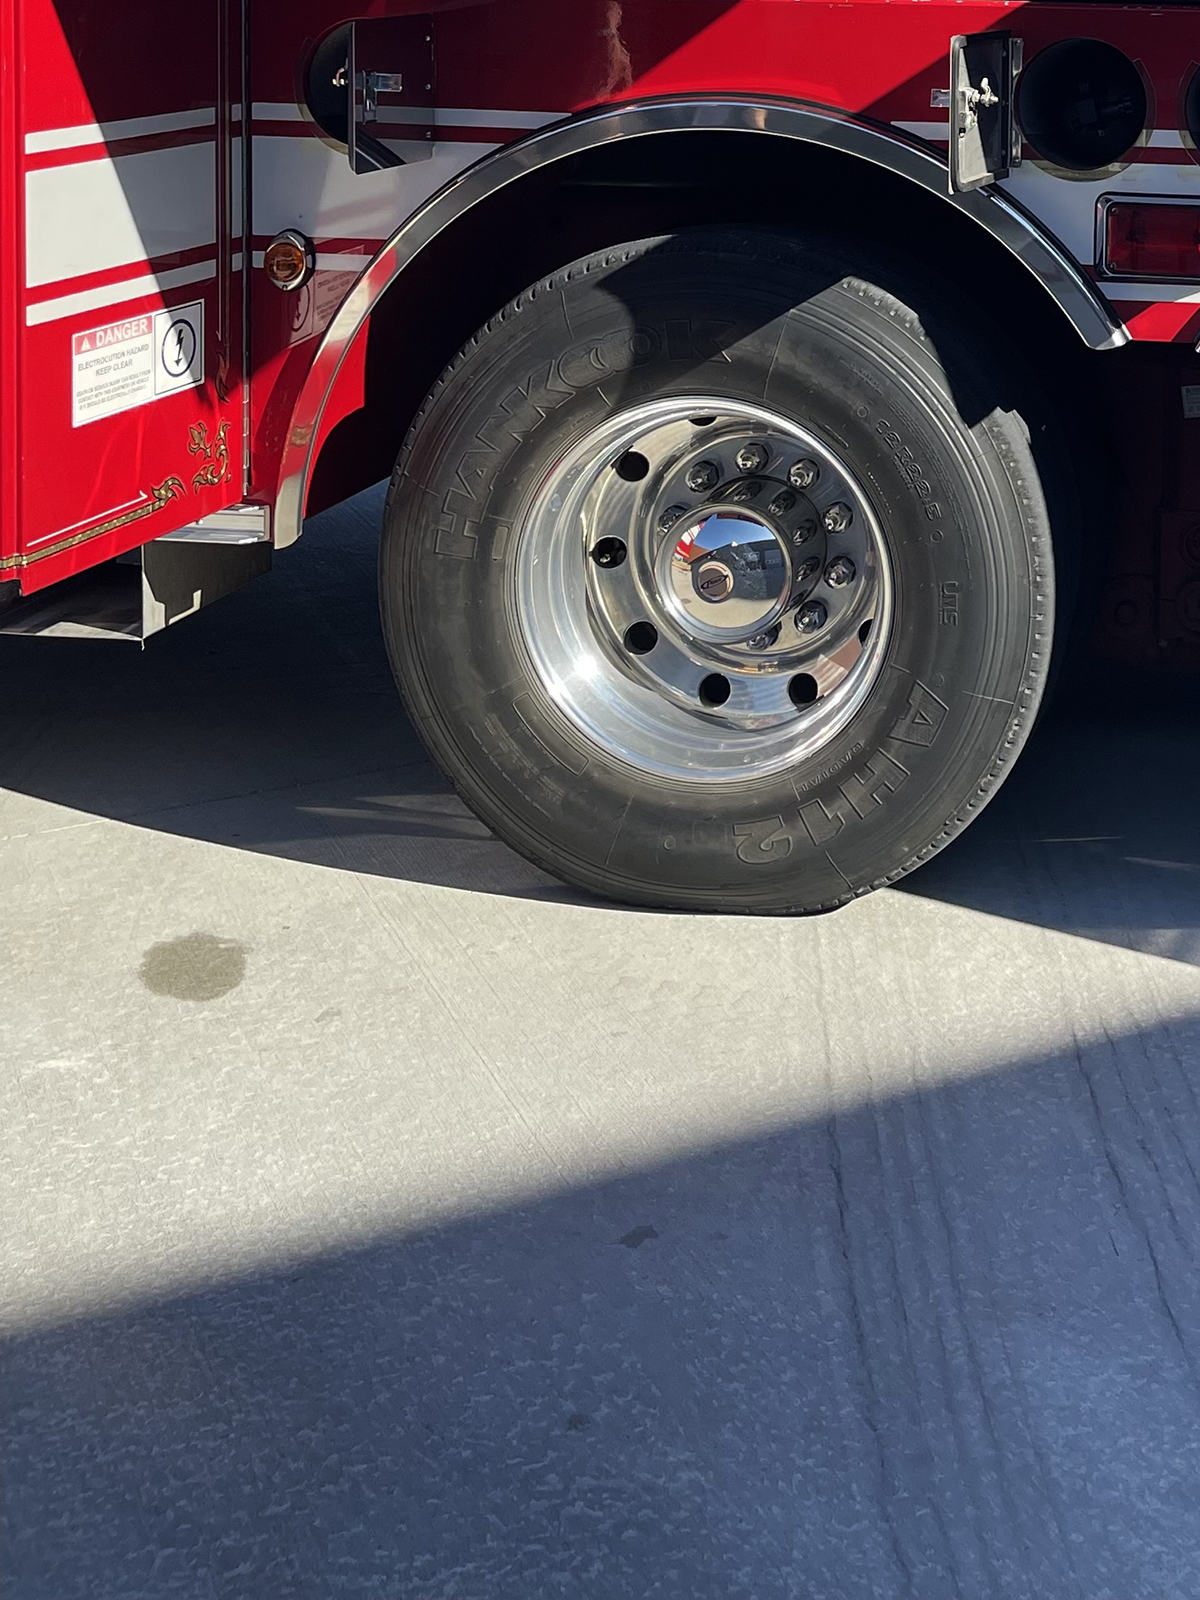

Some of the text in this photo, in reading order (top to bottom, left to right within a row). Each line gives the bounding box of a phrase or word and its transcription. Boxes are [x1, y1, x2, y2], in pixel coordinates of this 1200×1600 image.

[96, 318, 148, 347] DANGER
[78, 343, 149, 372] ELECTROCUTION HAZARD
[95, 359, 133, 377] KEEP CLEAR
[795, 741, 865, 793] RADIAL
